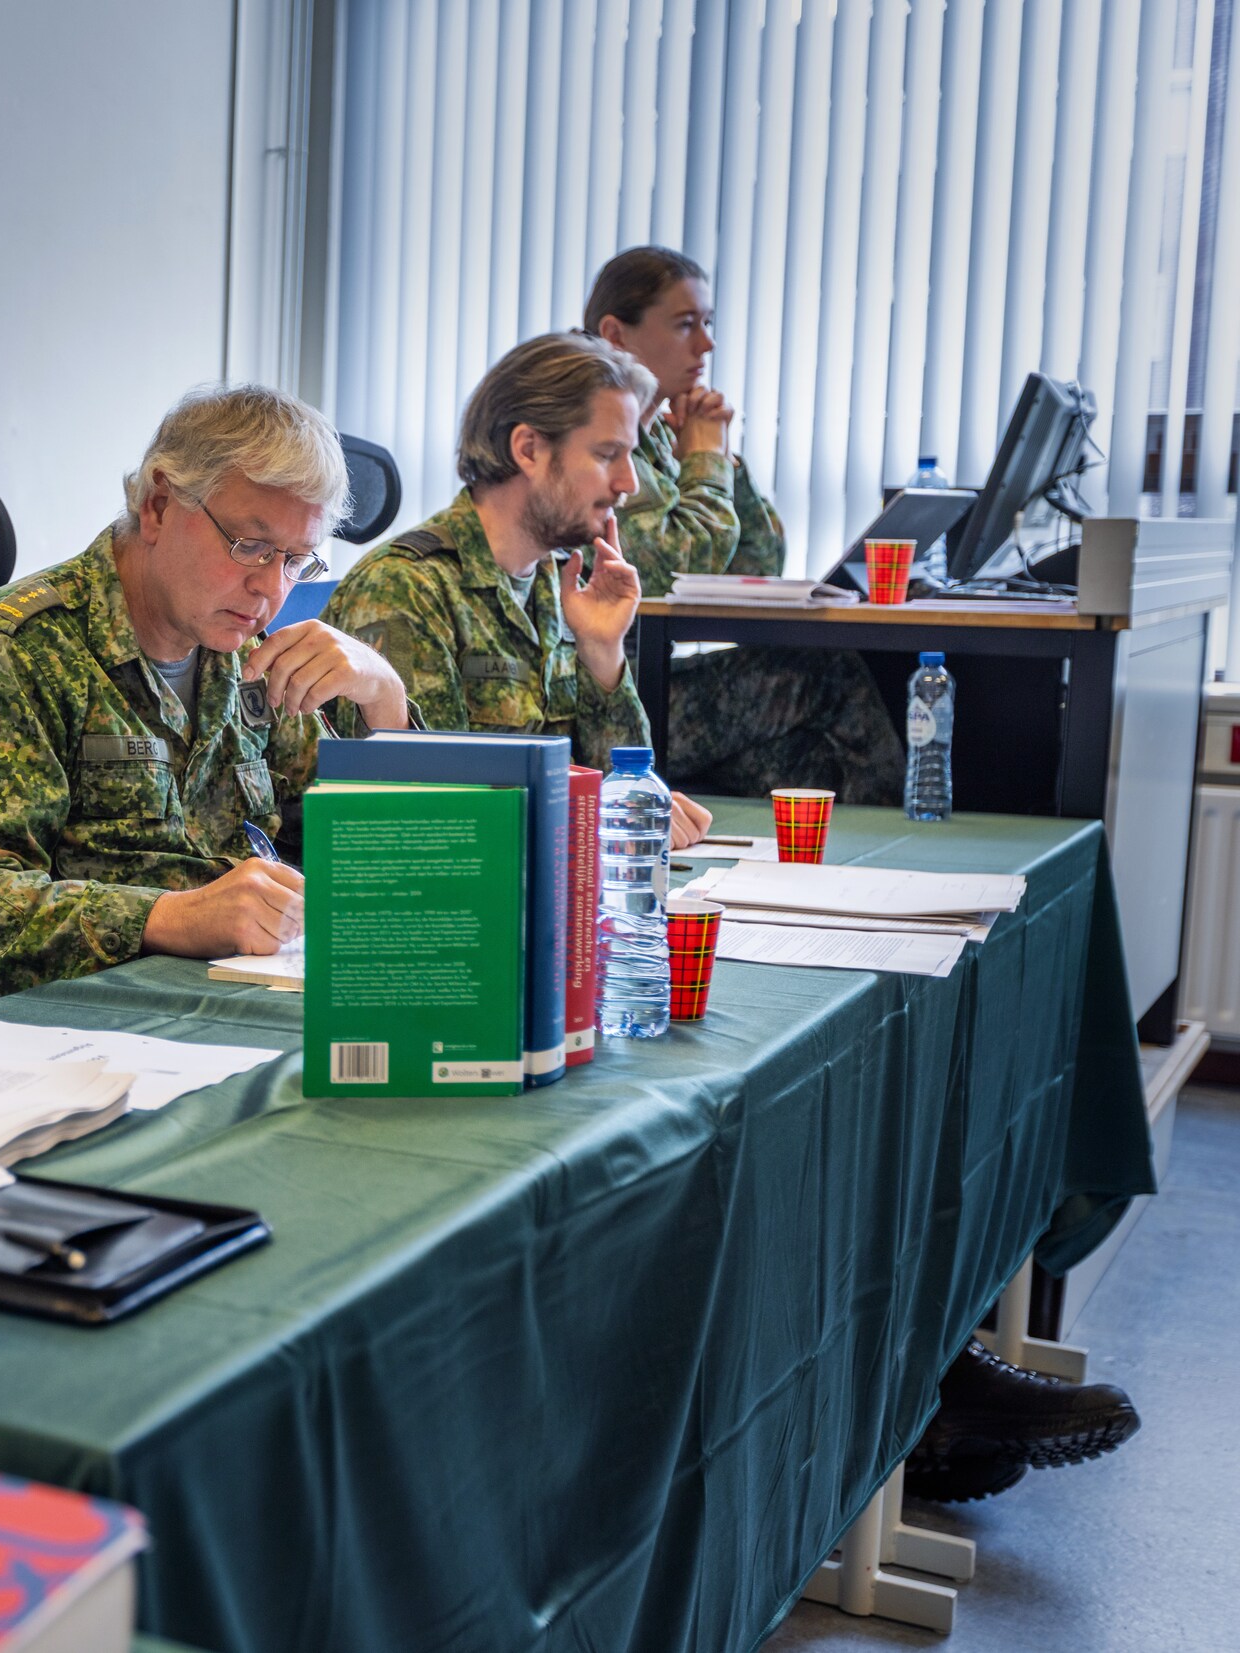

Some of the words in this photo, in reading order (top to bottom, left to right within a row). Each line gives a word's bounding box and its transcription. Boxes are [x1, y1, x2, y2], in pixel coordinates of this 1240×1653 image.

[575, 795, 587, 892] strafrechtelijke
[587, 795, 597, 888] Internationaal
[573, 895, 584, 988] samenwerking
[584, 892, 594, 955] strafrecht
[584, 958, 591, 971] en
